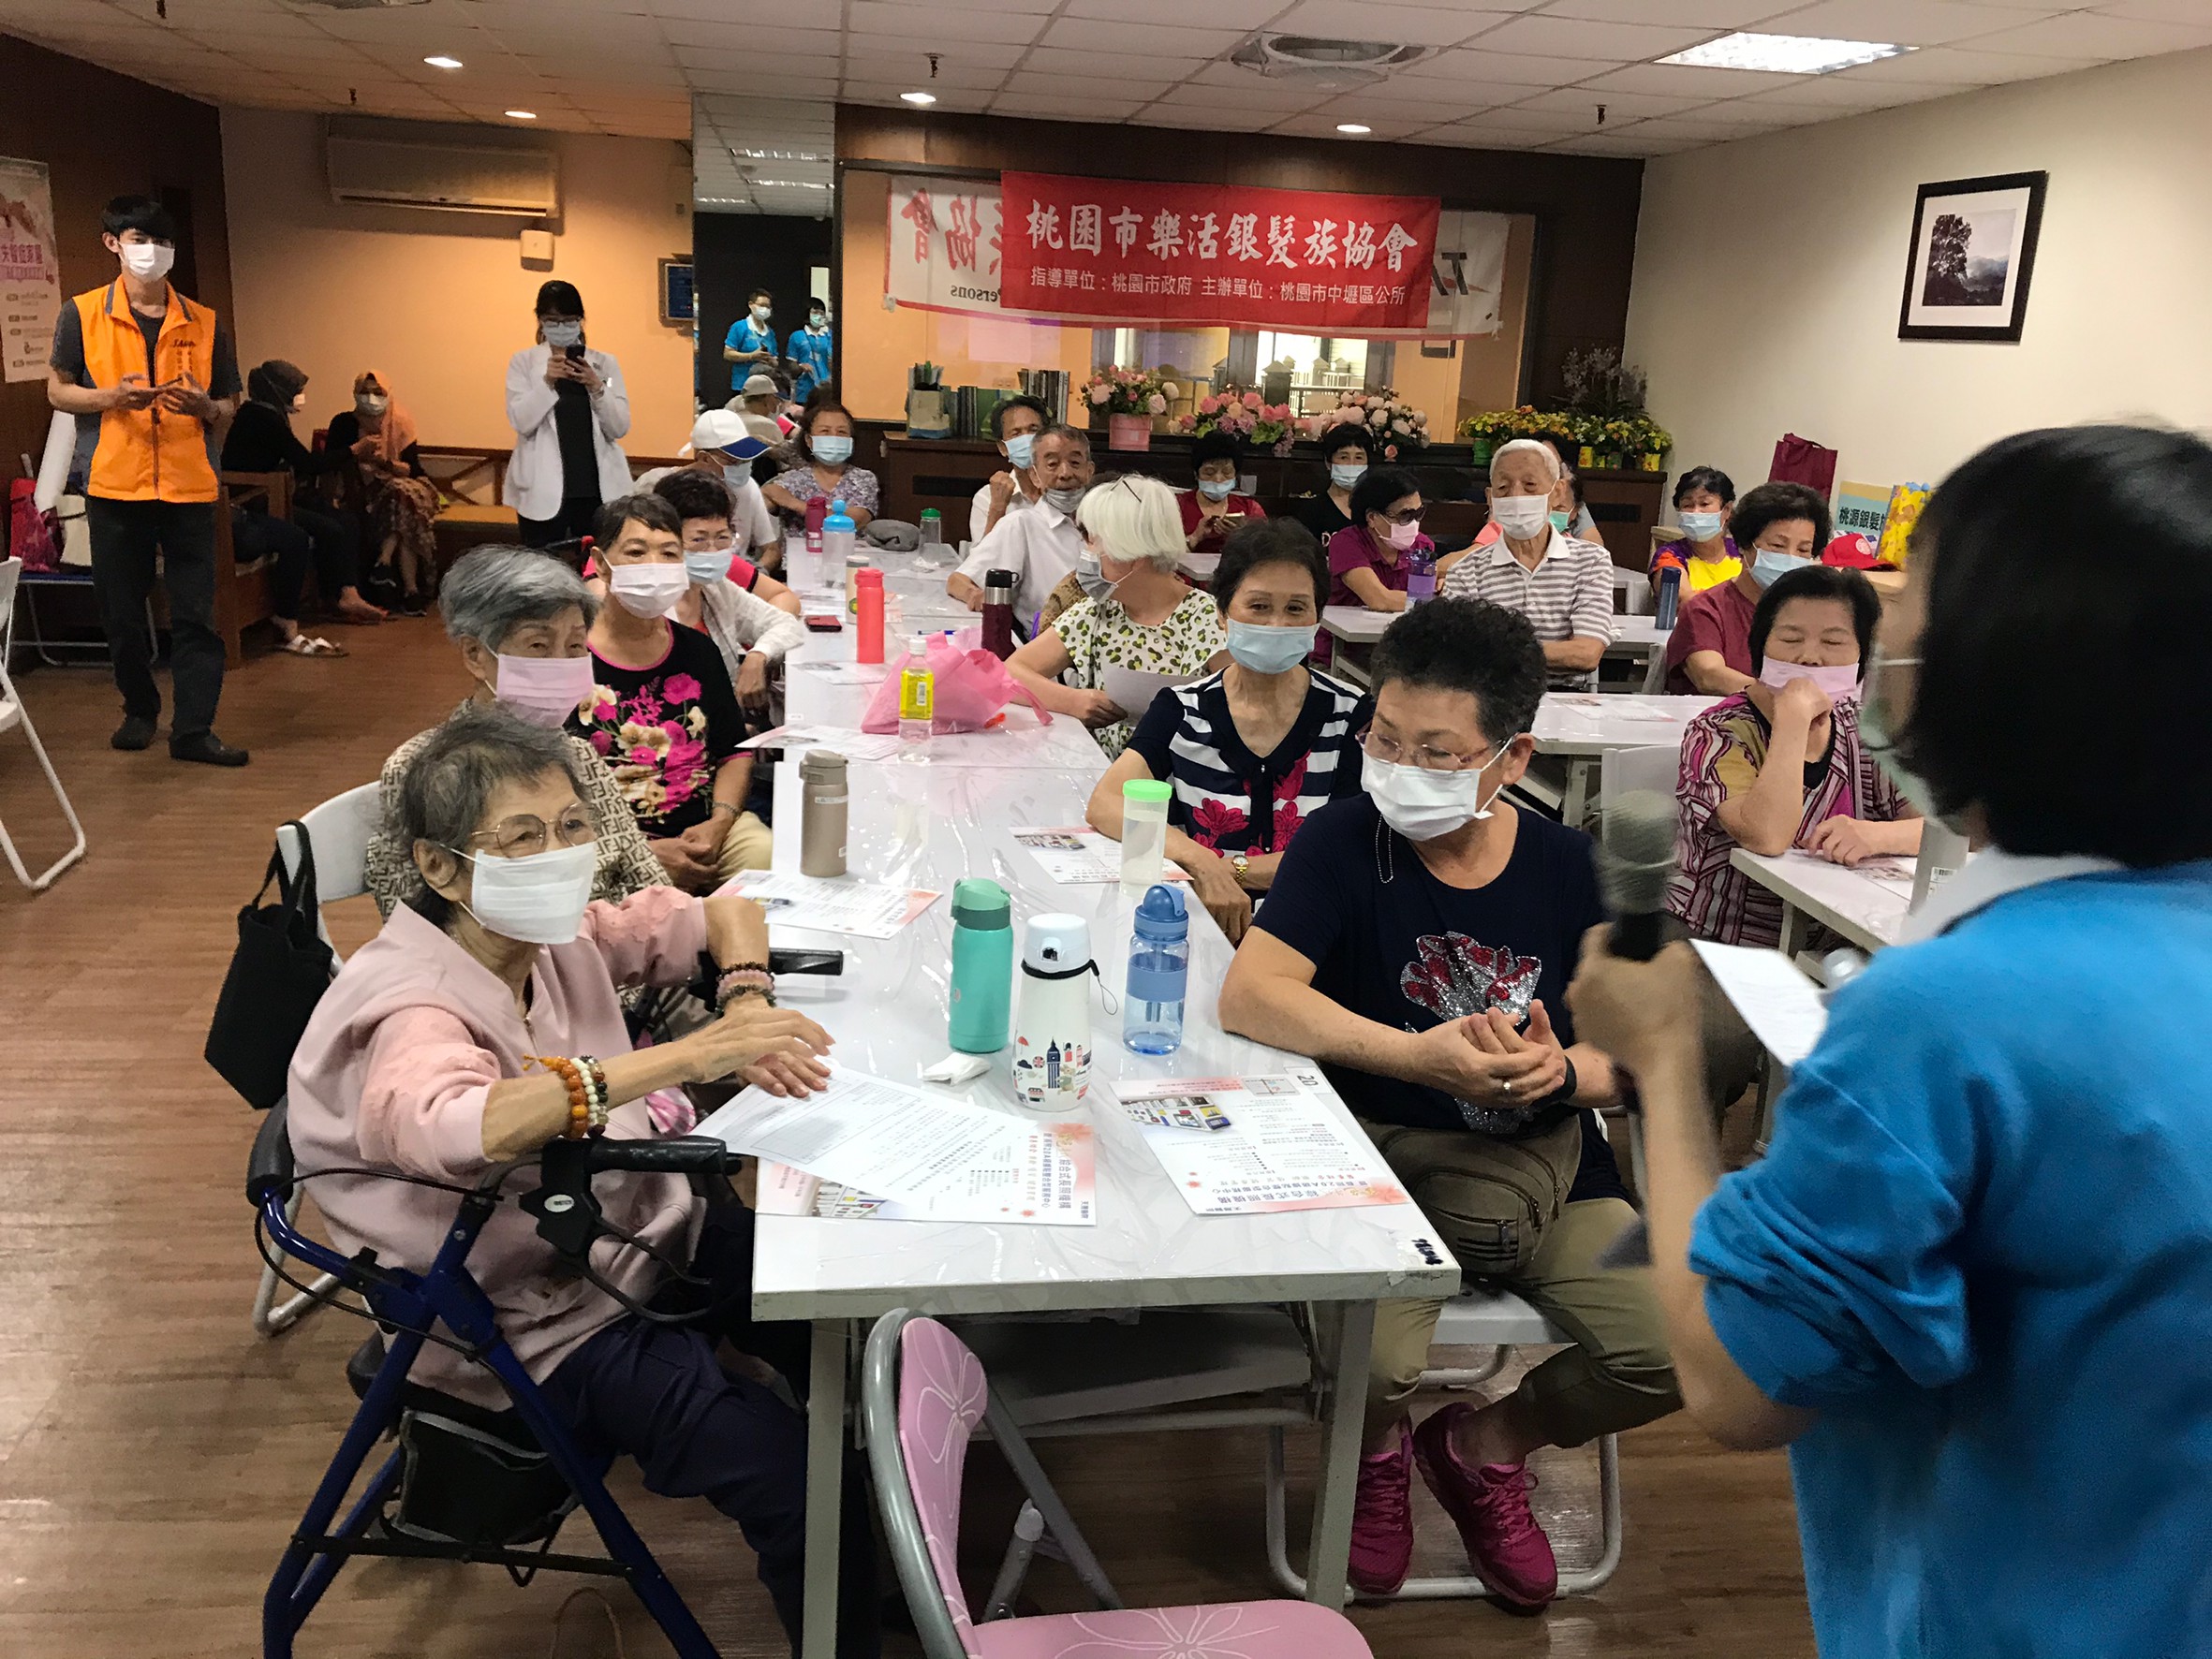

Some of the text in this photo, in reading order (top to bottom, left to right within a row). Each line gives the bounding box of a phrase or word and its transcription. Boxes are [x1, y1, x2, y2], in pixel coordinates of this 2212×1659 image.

[1026, 199, 1418, 272] 桃園市樂活銀髮族協會
